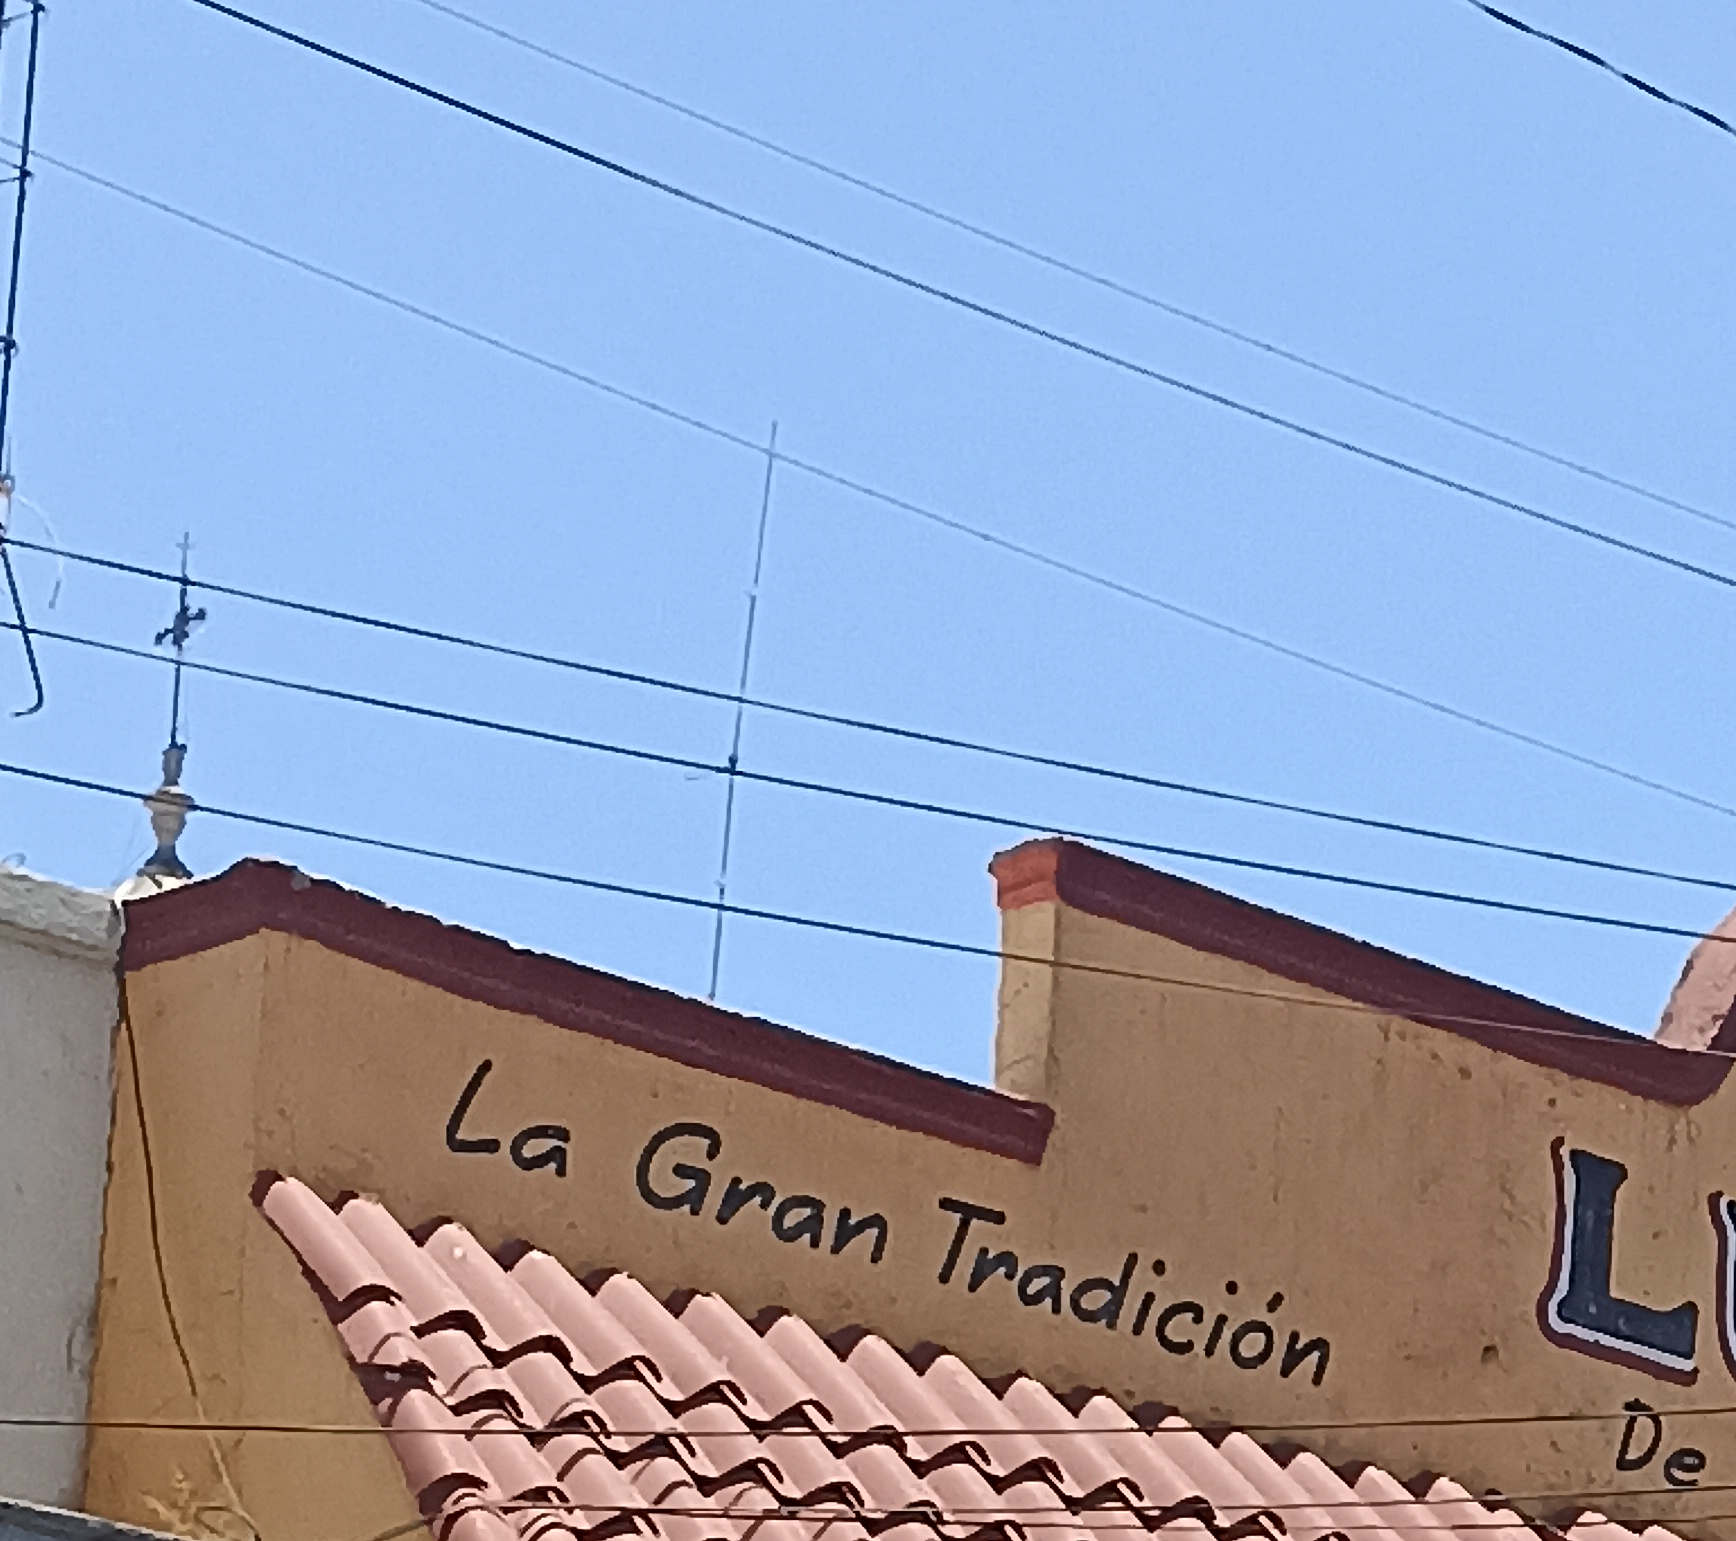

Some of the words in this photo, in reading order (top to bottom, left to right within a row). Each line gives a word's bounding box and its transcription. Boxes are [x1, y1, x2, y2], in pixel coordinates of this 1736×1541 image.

[444, 1058, 571, 1177] La
[635, 1121, 889, 1264] Gran
[937, 1197, 1331, 1387] Tradición
[1613, 1400, 1707, 1489] De
